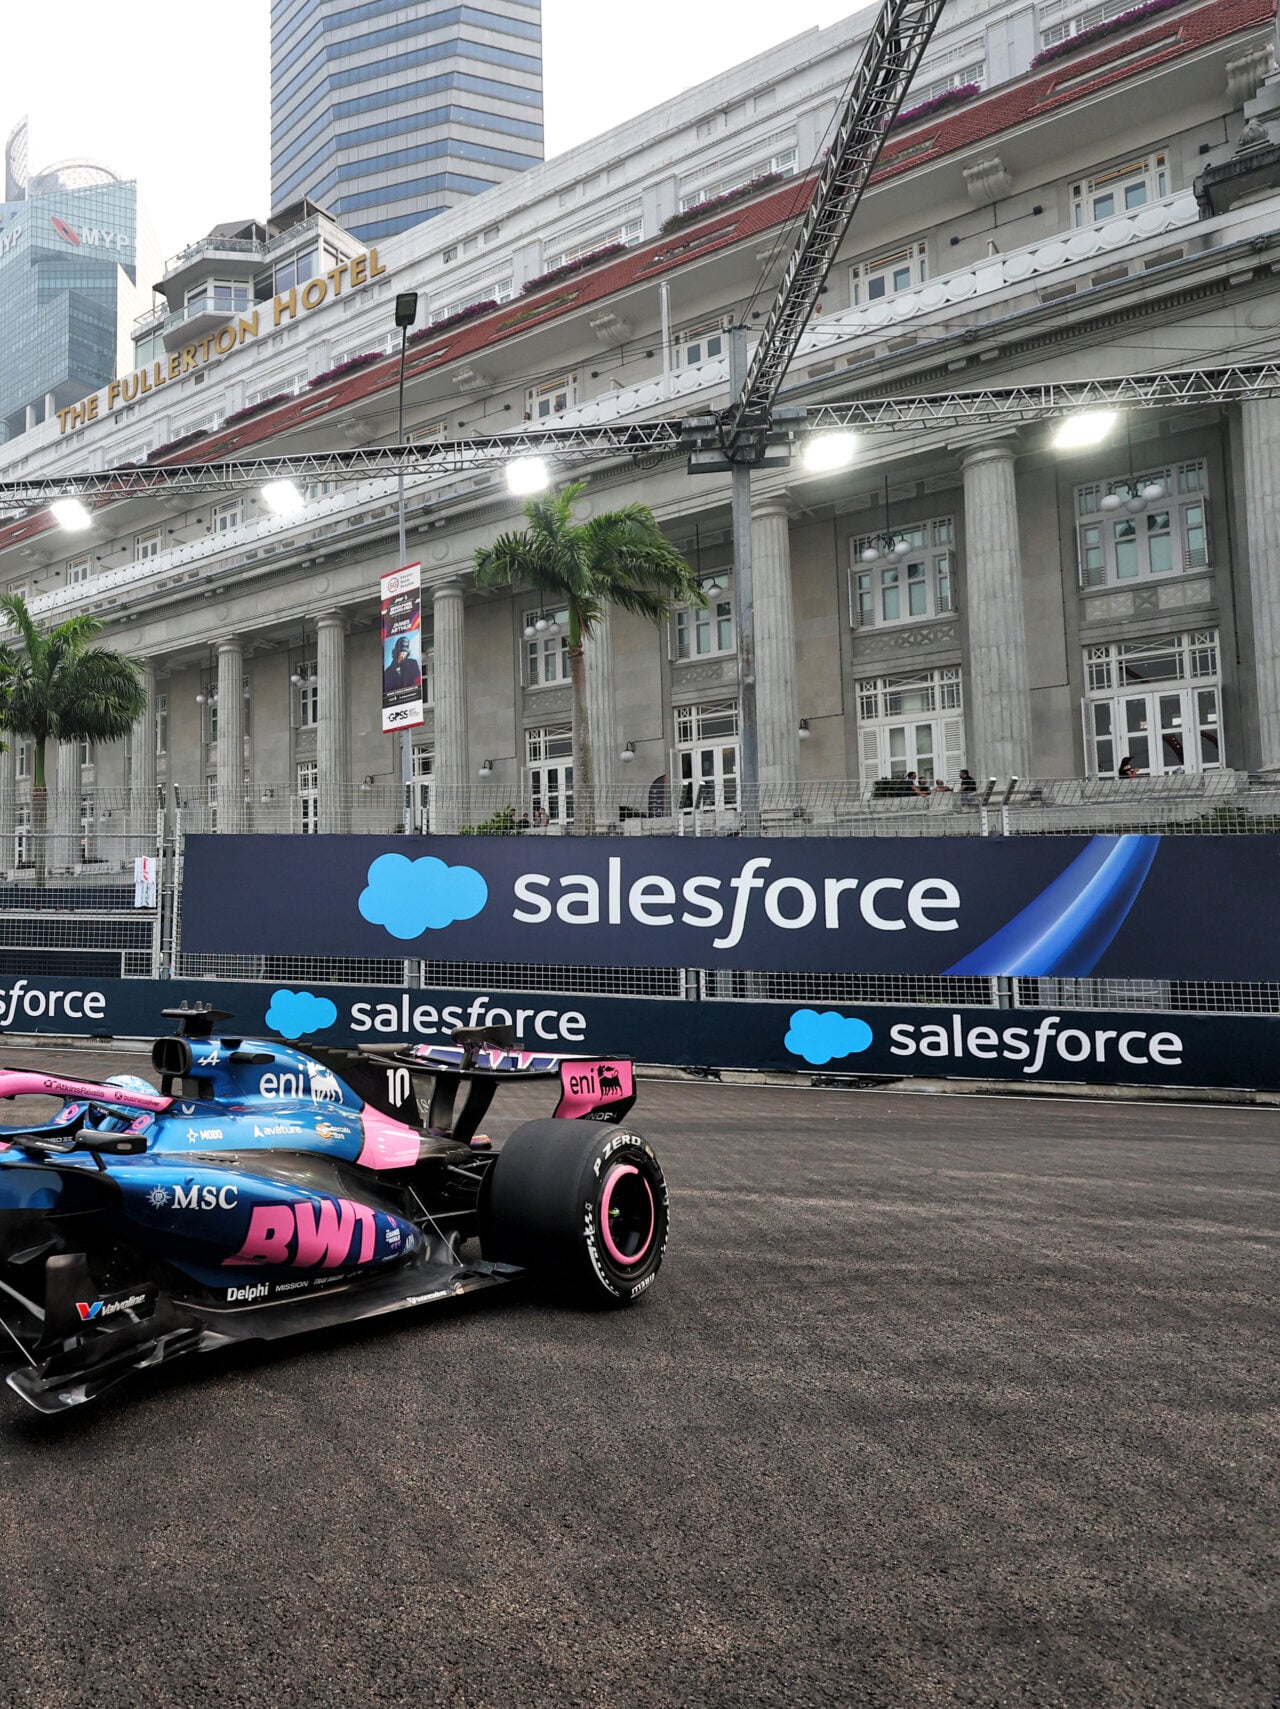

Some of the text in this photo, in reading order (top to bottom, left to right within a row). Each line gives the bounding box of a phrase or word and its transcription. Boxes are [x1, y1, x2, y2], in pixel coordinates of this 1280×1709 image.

[81, 226, 131, 250] MYP
[56, 248, 387, 434] THE FULLERTON HOTEL
[512, 856, 961, 949] salesforce
[350, 993, 588, 1042] salesforce
[889, 1013, 1184, 1075] salesforce
[259, 1073, 304, 1099] eni
[386, 1067, 410, 1109] 10
[569, 1066, 596, 1096] eni
[199, 1129, 224, 1141] MODO
[263, 1125, 303, 1137] avature
[593, 1133, 642, 1178] P ZERO
[171, 1184, 239, 1211] MSC
[221, 1198, 377, 1269] BWT
[101, 1294, 146, 1316] Valvoline
[226, 1281, 310, 1303] Delphi MISSION
